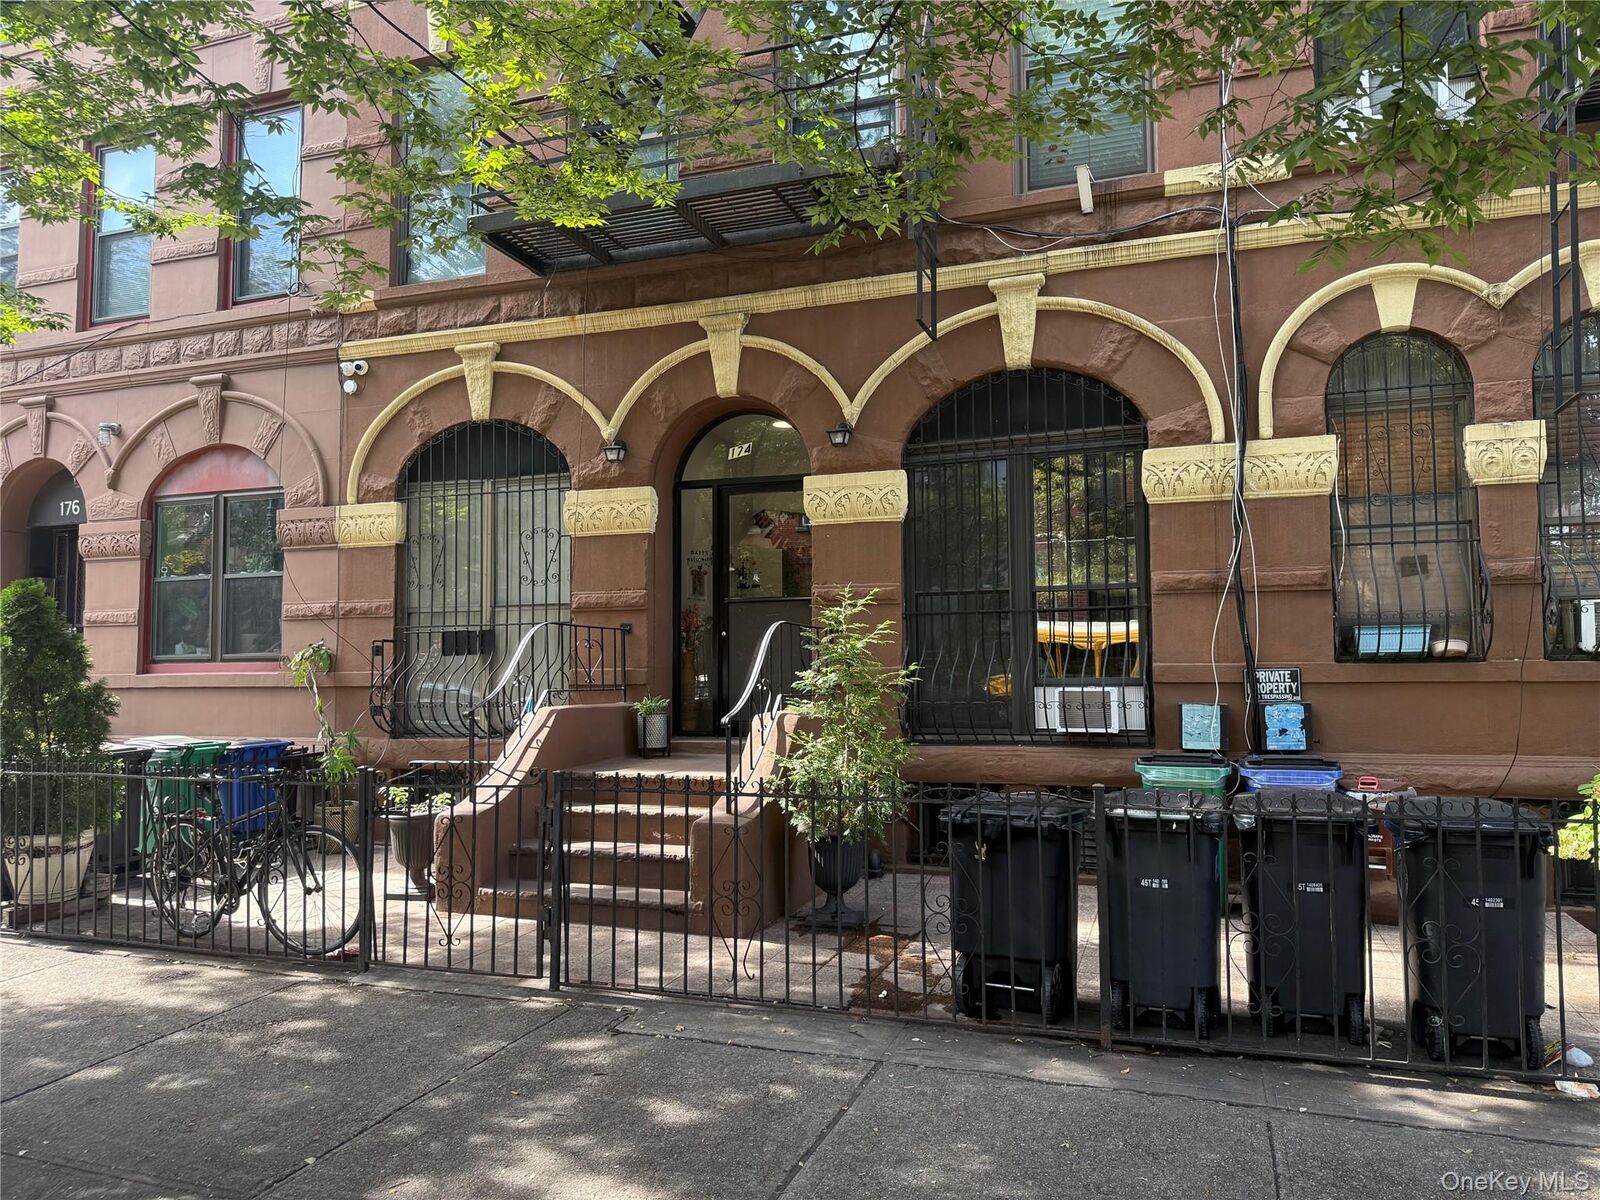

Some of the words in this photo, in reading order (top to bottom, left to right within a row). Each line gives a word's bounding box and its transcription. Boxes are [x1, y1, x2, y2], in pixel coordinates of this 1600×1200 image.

[732, 444, 751, 457] 174
[60, 500, 80, 516] 176
[1257, 682, 1297, 694] OPERTY
[1140, 879, 1151, 887] 45T
[1297, 883, 1306, 891] 5T
